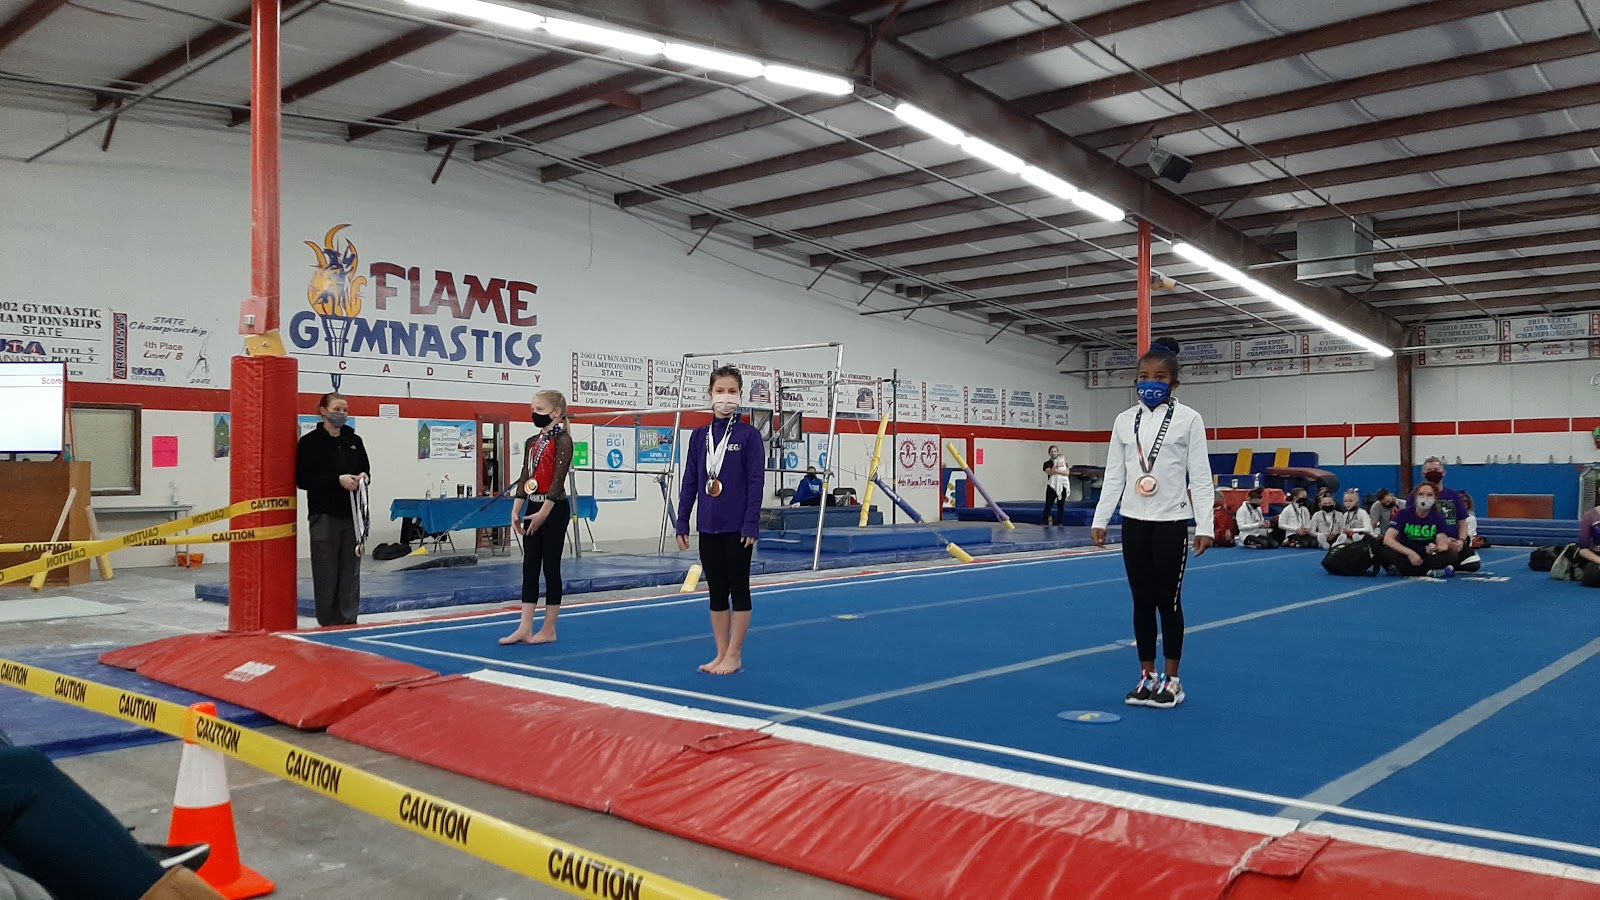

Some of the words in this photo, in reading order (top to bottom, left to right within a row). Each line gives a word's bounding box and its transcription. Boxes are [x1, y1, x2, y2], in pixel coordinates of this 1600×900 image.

[370, 262, 538, 327] FLAME
[22, 303, 102, 318] GYMNASTIC
[152, 316, 187, 325] STATE
[22, 326, 63, 337] STATE
[129, 321, 208, 337] Championship
[51, 347, 81, 355] LEVEL
[115, 315, 126, 378] ARKANSAS
[160, 342, 183, 351] Place
[143, 350, 171, 360] Level
[175, 352, 183, 360] 8
[597, 353, 644, 364] GYMNASTICS
[581, 360, 642, 371] CHAMPIONSHIPS
[669, 360, 711, 370] GYNASTICS
[601, 369, 624, 378] STATE
[656, 367, 710, 377] CHAMPNSHIPS
[673, 375, 694, 383] STTE
[580, 380, 608, 392] USA
[599, 398, 637, 407] GYMNASTICS
[606, 438, 625, 447] BGI
[250, 497, 290, 510] CAUTION
[212, 529, 255, 542] CAUTION
[23, 542, 72, 552] CAUTION
[0, 662, 29, 686] CAUTION
[54, 678, 87, 703] CAUTION
[118, 694, 157, 723] CAUTION
[196, 716, 241, 753] CAUTION
[285, 750, 342, 794] CAUTION
[399, 792, 471, 845] CAUTION
[547, 848, 645, 900] CAUTION
